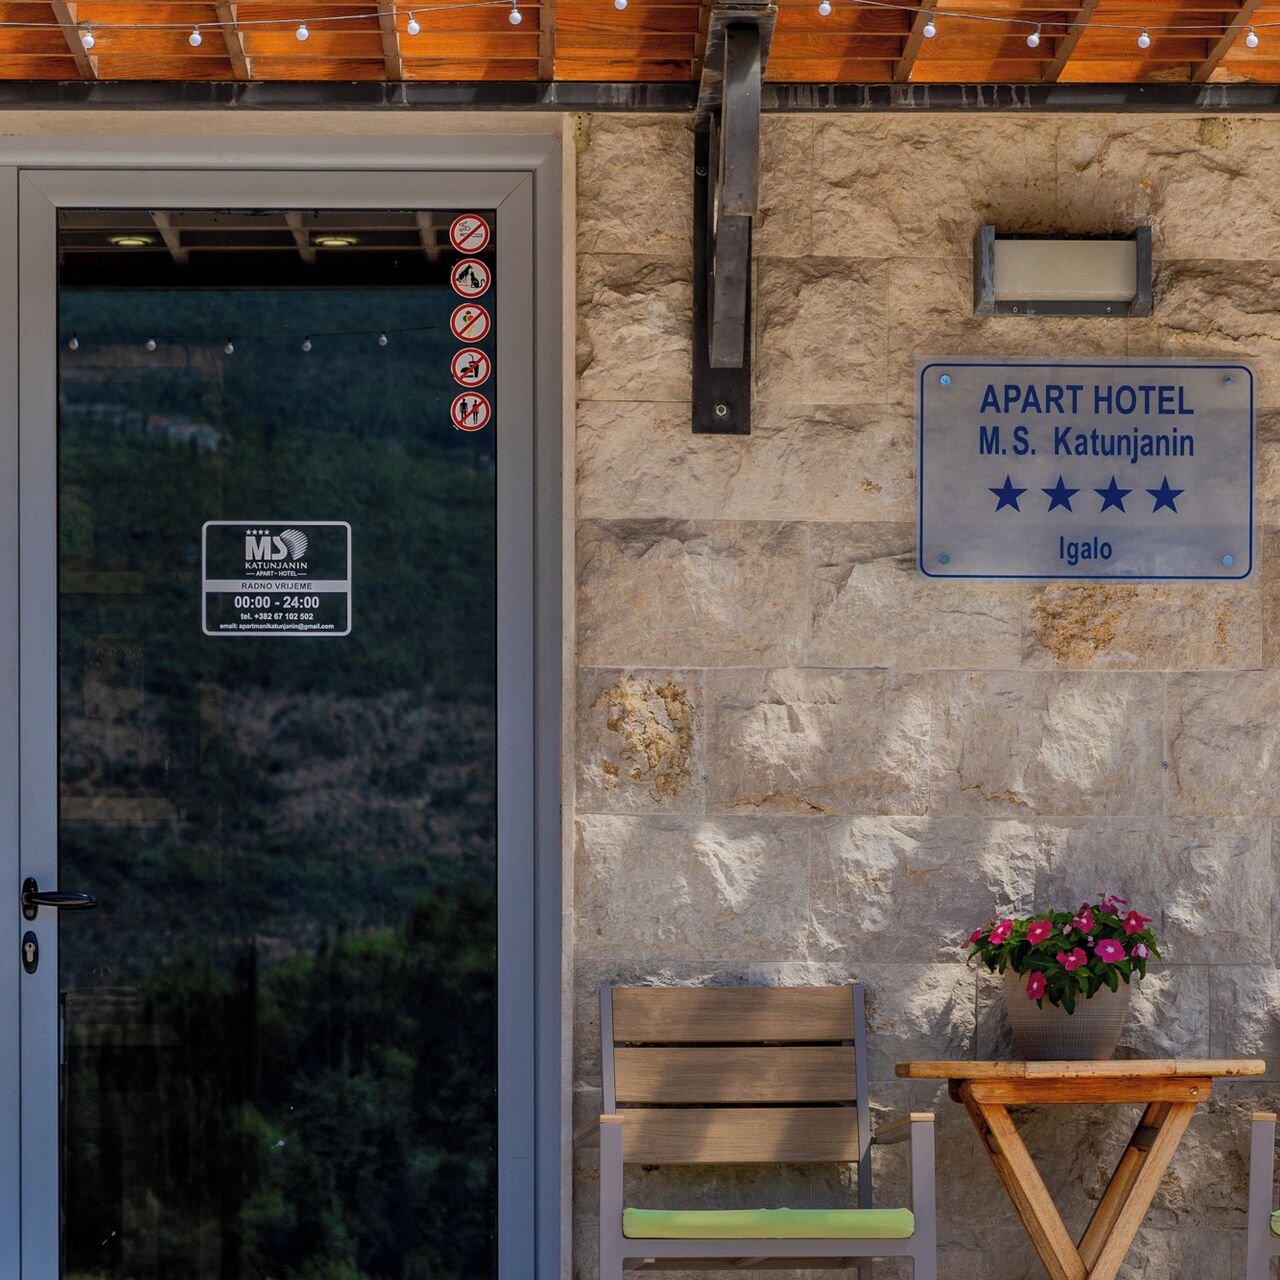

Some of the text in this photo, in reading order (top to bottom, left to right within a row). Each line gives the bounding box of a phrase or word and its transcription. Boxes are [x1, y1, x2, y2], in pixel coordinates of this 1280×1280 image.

[980, 385, 1195, 415] APART HOTEL
[1054, 427, 1195, 464] Katunjanin
[1059, 536, 1113, 566] Igalo
[234, 596, 271, 608] 00:00
[282, 596, 320, 608] 24:00
